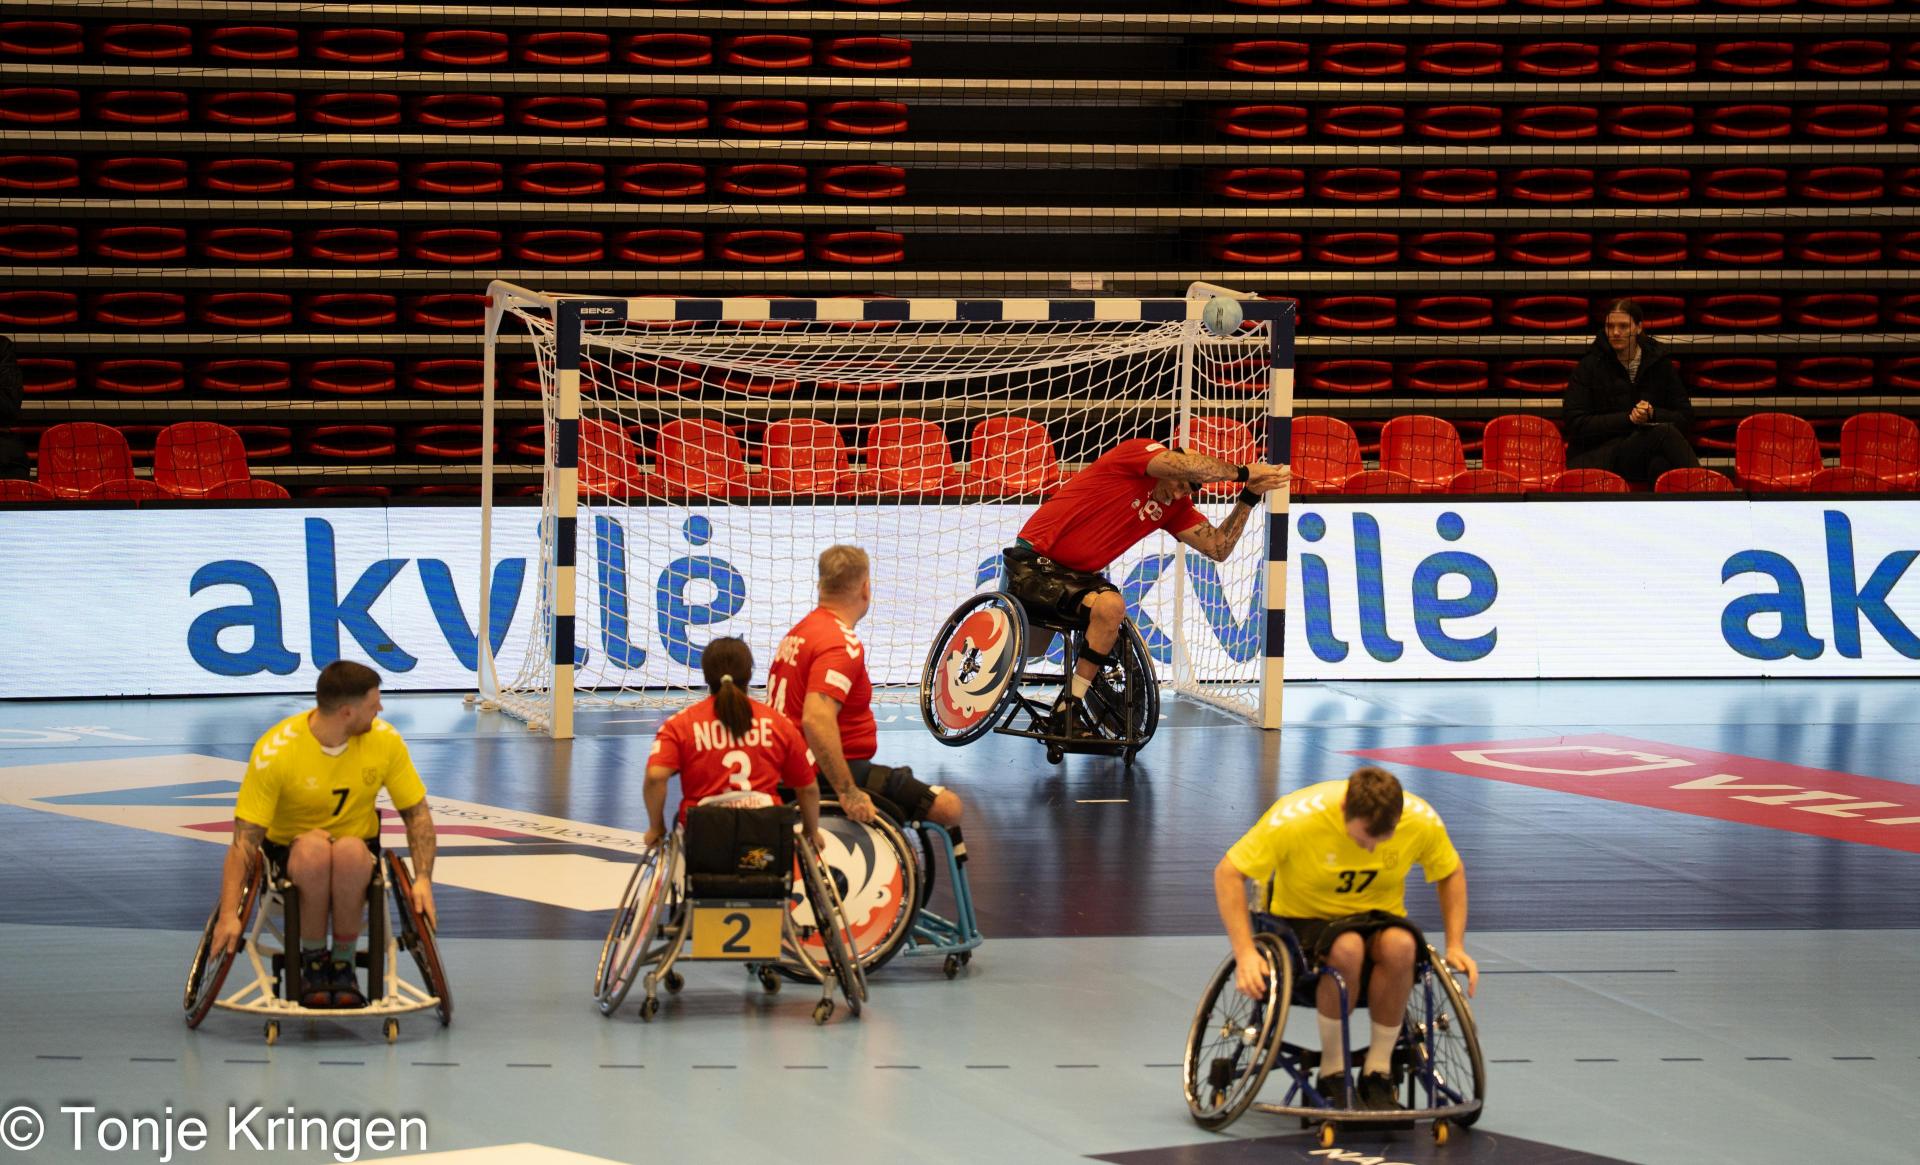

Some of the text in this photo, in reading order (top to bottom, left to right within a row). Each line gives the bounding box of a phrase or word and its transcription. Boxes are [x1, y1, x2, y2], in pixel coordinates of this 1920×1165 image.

[187, 515, 746, 677] akvlė
[975, 510, 1498, 662] vilė
[721, 750, 752, 793] 3
[332, 788, 350, 816] 7
[1669, 773, 1920, 825] VIL
[1335, 870, 1378, 894] 37
[722, 912, 751, 953] 2
